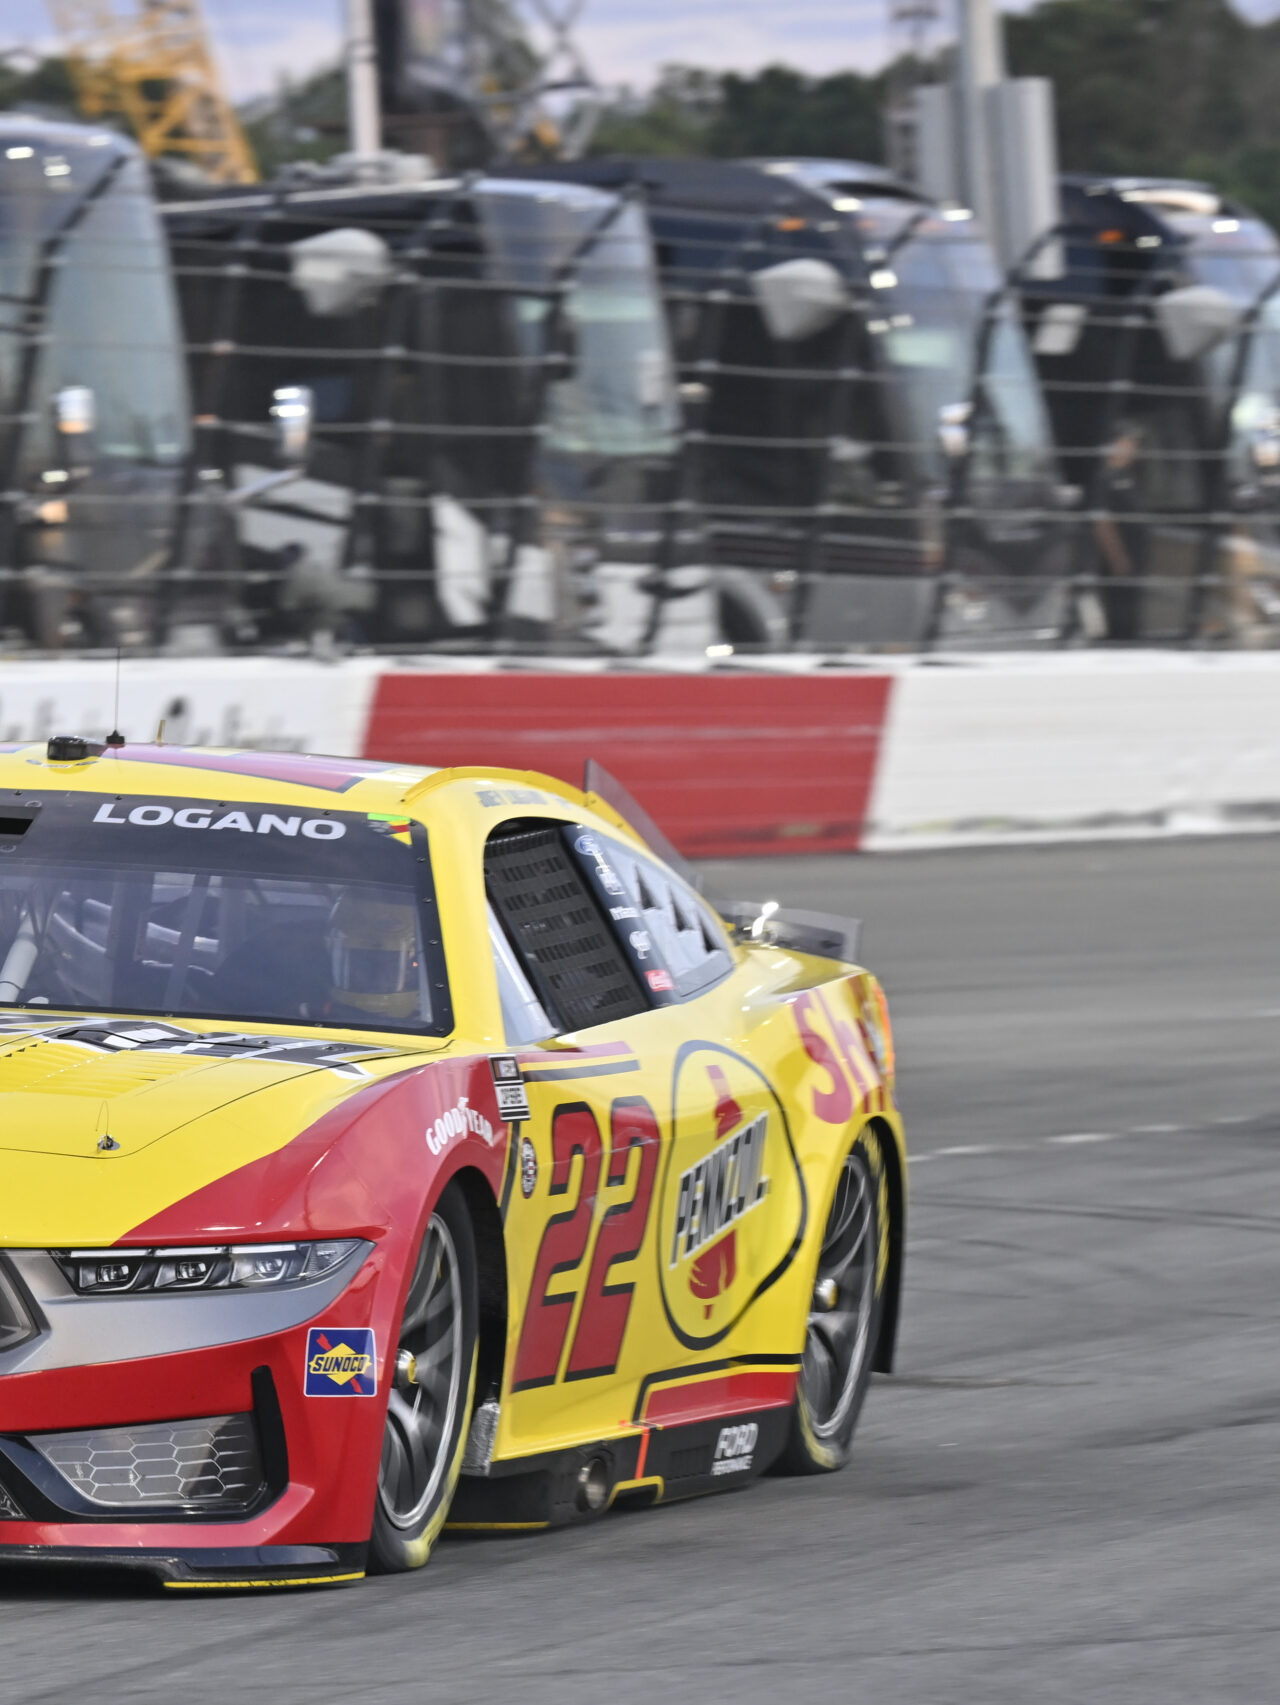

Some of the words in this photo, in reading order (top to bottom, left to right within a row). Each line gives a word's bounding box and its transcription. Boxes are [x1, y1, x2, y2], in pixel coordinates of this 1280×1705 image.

[92, 803, 347, 840] LOGANO
[511, 1095, 660, 1394] 22
[310, 1355, 370, 1374] SUNOCO
[714, 1422, 759, 1459] FORD
